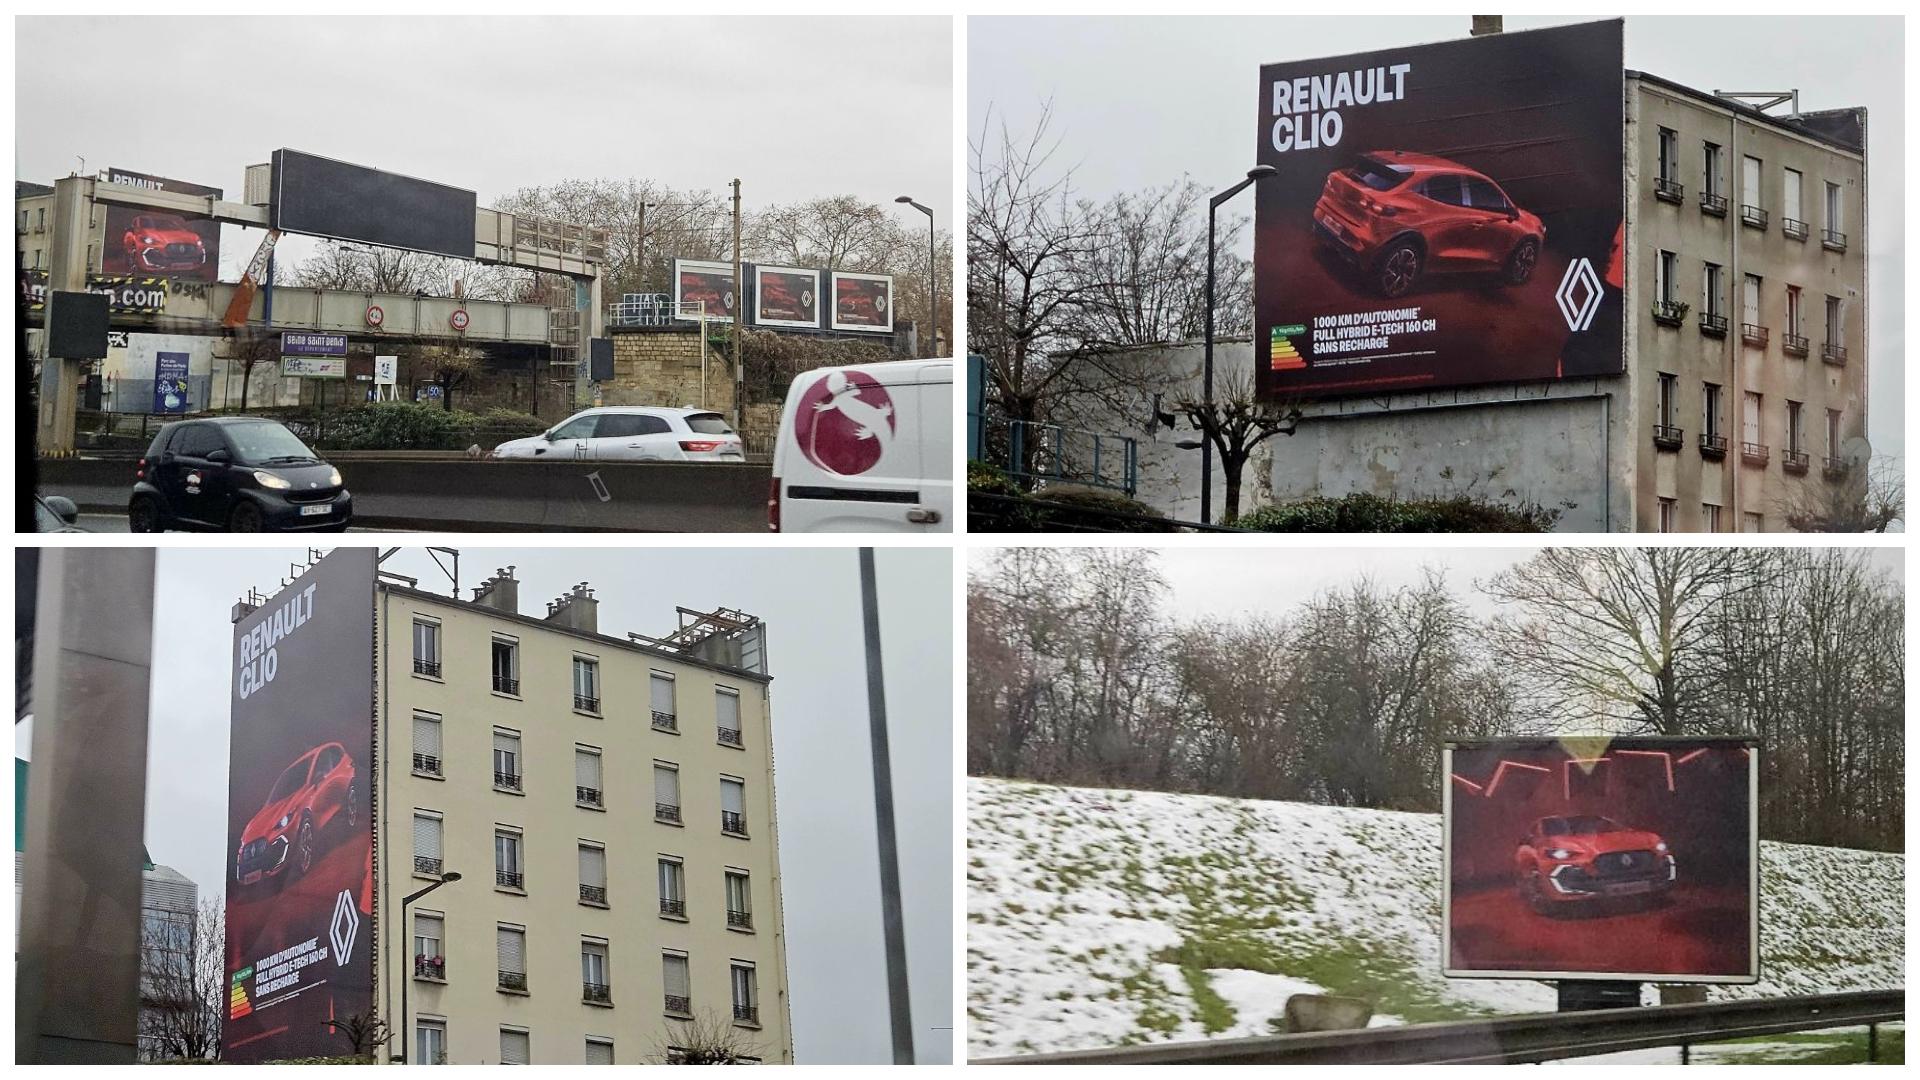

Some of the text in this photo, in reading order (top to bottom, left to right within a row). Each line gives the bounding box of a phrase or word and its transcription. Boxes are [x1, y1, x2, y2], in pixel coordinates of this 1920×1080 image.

[1273, 64, 1410, 115] RENAULT
[1272, 111, 1343, 152] CLIO
[1313, 328, 1335, 341] FULL
[1336, 325, 1371, 339] HYBRID
[1372, 322, 1404, 336] E-TECH
[1406, 321, 1420, 333] 160
[1422, 320, 1436, 331] CH
[1338, 313, 1352, 325] KM
[1313, 337, 1388, 354] SANS RECHARGE
[430, 387, 438, 396] 50
[241, 583, 316, 668] RENAULT
[240, 647, 277, 699] CLIO
[256, 972, 268, 984] FULL
[269, 962, 288, 980] HYBRID
[289, 955, 308, 972] E-TECH
[309, 950, 318, 964] 160
[319, 946, 328, 960] CH
[256, 983, 270, 997] SANS
[271, 971, 299, 993] RECHARGE
